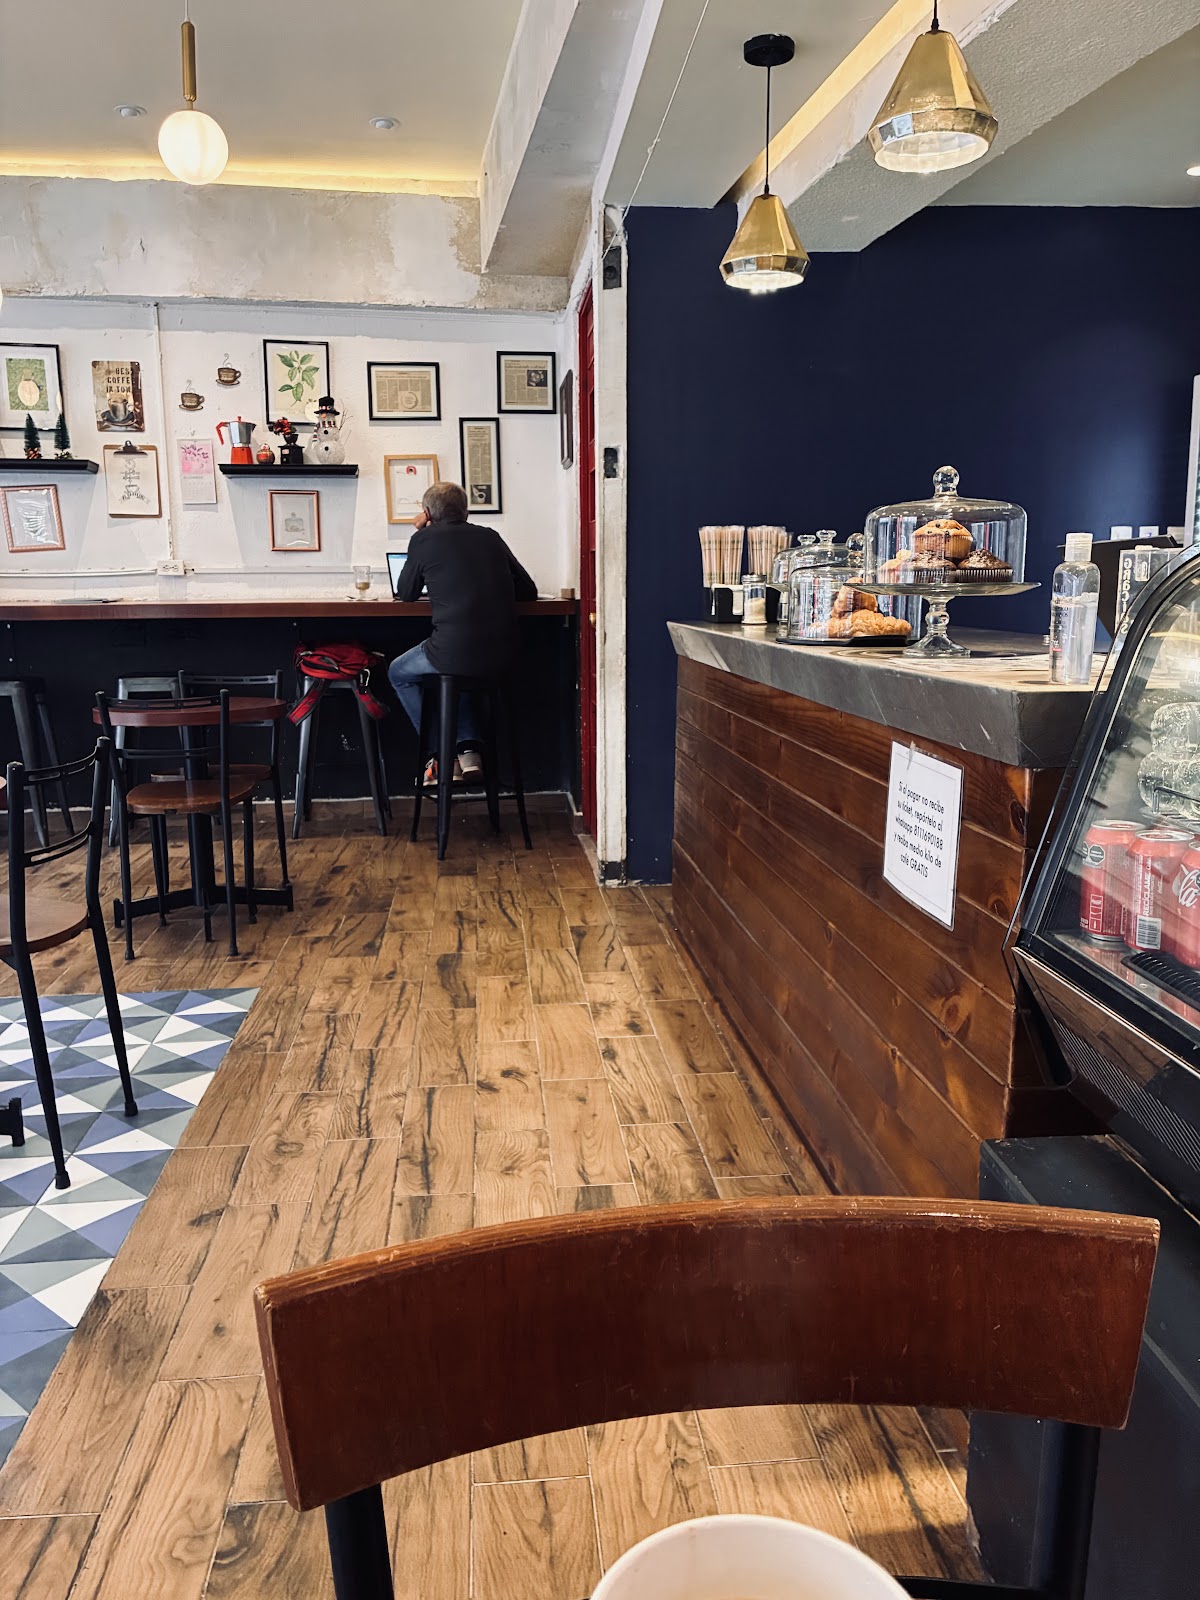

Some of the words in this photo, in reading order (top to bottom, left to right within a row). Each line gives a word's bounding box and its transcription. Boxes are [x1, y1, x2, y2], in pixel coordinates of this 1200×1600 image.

[903, 784, 907, 794] al
[907, 789, 921, 803] pagar
[921, 796, 928, 806] no
[929, 800, 945, 814] recibe
[897, 800, 901, 809] su
[914, 810, 937, 829] repórtelo
[937, 820, 943, 832] al
[897, 834, 909, 849] reciba
[909, 842, 924, 858] medio
[924, 848, 934, 864] kilo
[934, 855, 942, 868] de
[913, 825, 944, 851] 8111690188
[900, 852, 909, 866] café
[909, 858, 929, 878] GRATIS
